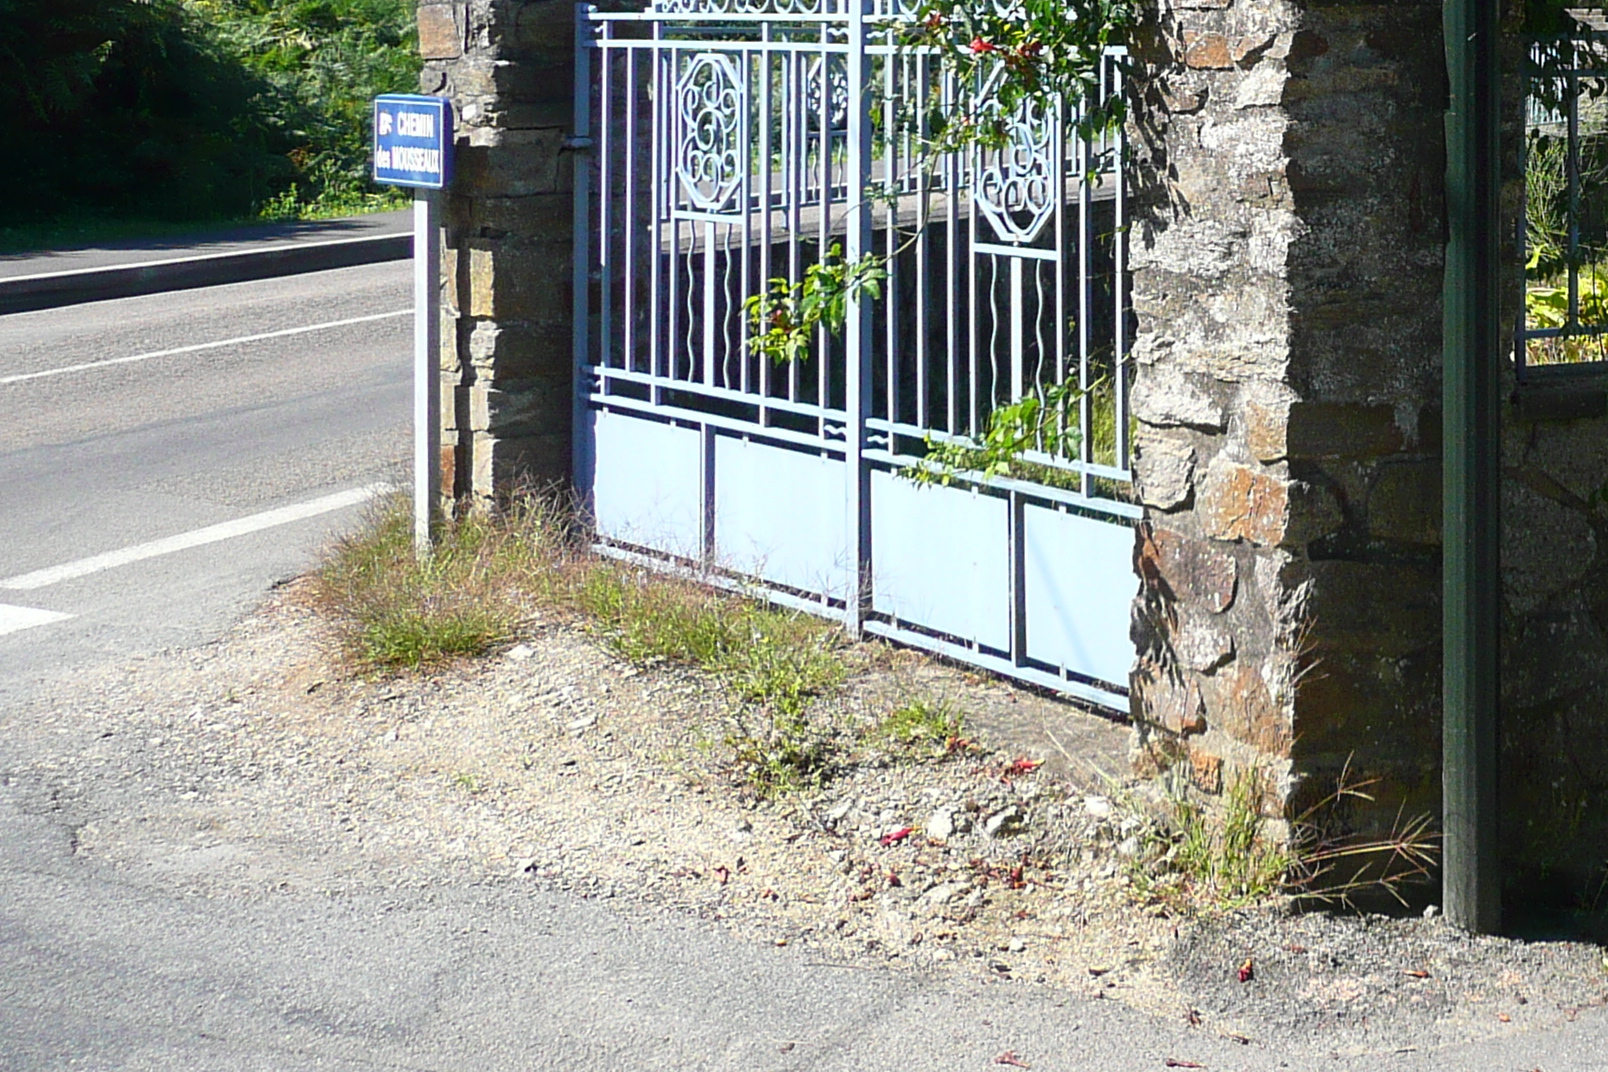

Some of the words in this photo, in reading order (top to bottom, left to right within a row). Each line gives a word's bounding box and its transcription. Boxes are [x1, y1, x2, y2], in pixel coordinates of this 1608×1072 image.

[397, 111, 434, 138] CHEMIN
[377, 145, 391, 169] des
[391, 146, 440, 174] MOUSSEAUX
